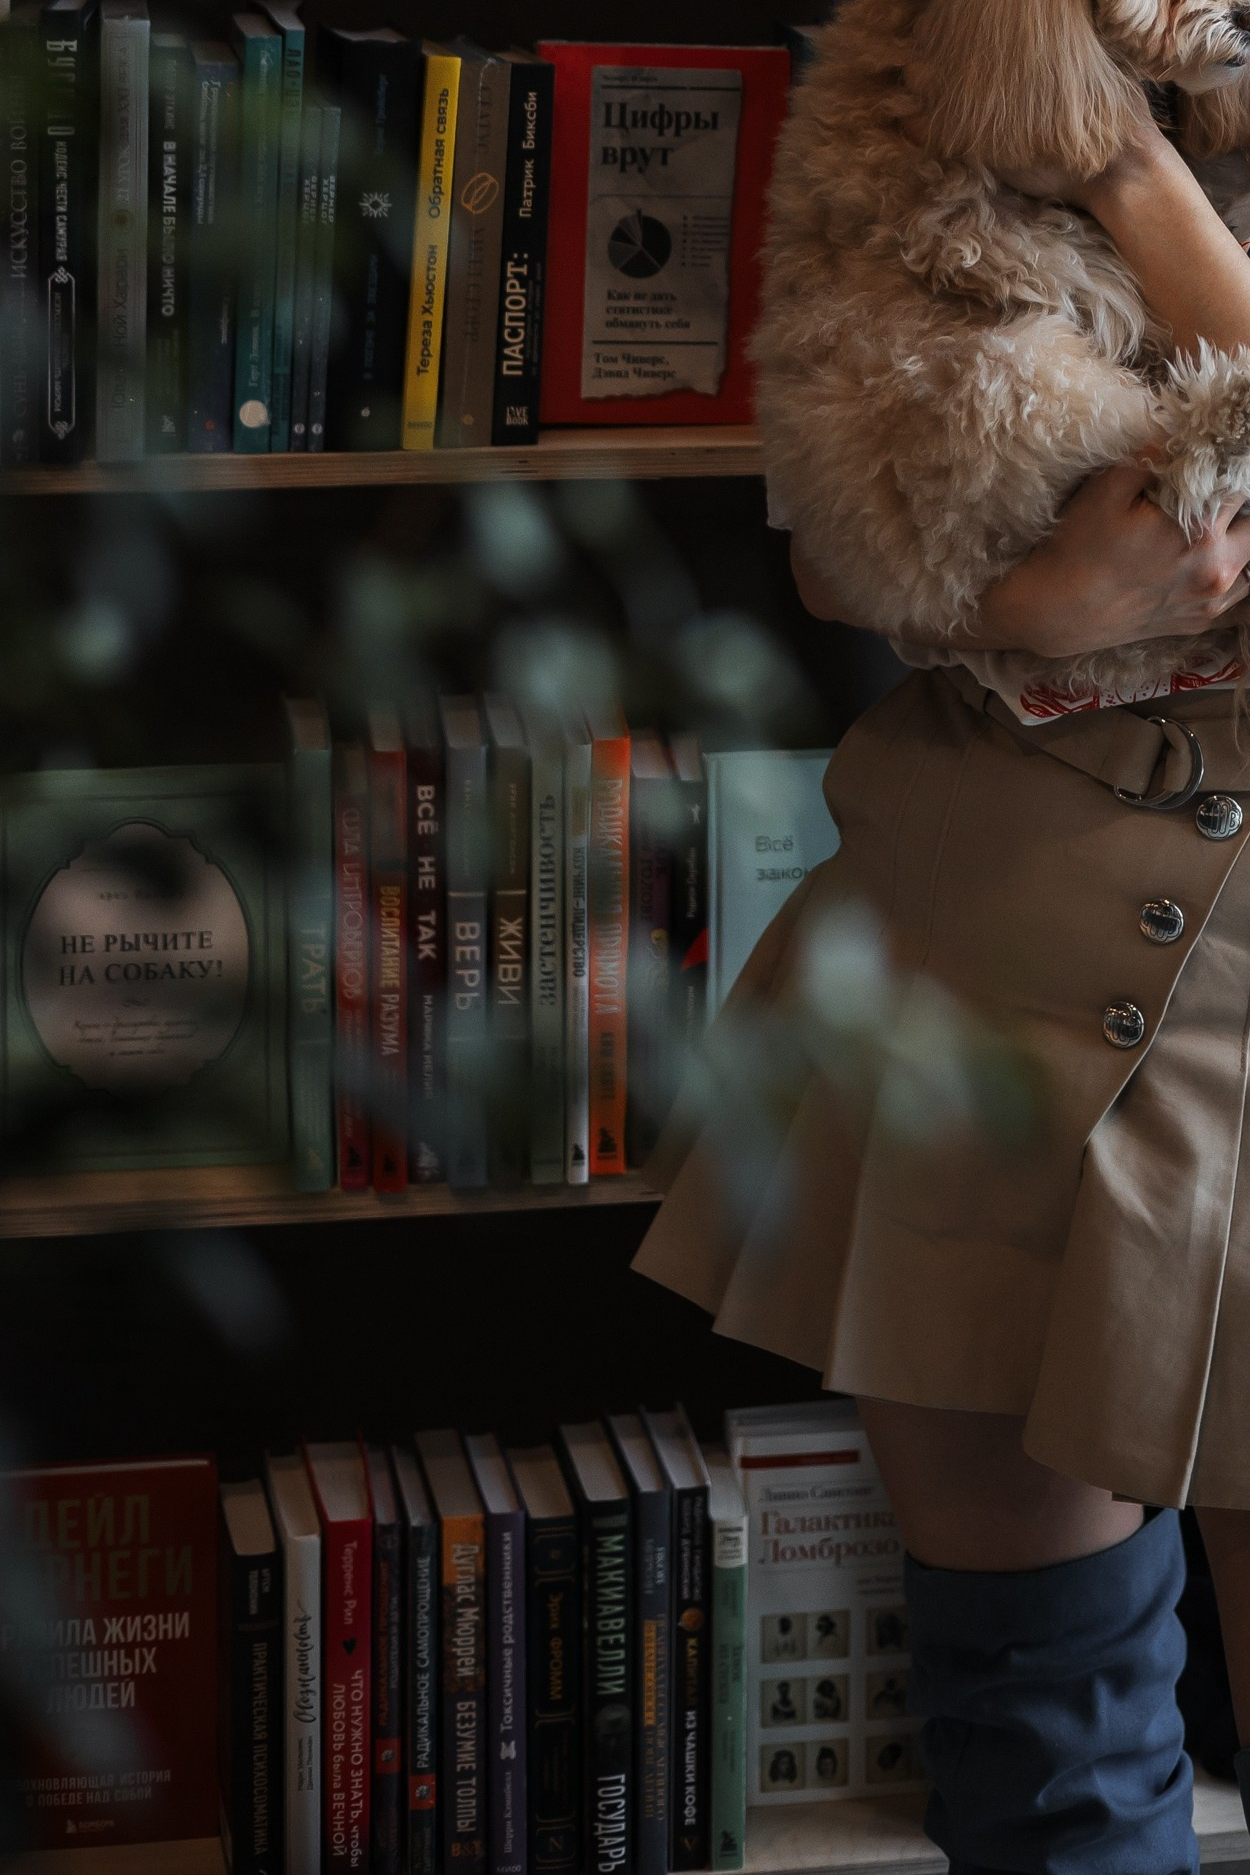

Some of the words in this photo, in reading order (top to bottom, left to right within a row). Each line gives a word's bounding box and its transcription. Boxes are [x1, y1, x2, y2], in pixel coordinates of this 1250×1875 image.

[434, 87, 451, 133] связь
[521, 90, 538, 149] Биксби
[602, 102, 719, 137] Цифры
[54, 141, 67, 180] КОДЕКС
[162, 141, 175, 151] В
[601, 142, 674, 173] врут
[55, 183, 67, 212] ЧЕСТИ
[161, 154, 175, 213] НАЧАЛЕ
[427, 138, 445, 218] Обратная
[519, 159, 536, 217] Патрик
[10, 158, 29, 278] ИСКУССТВО
[54, 215, 67, 262] САМУРАЯ
[160, 266, 174, 316] НИЧТО
[421, 244, 438, 315] Хьюстон
[502, 251, 528, 375] ПАСПОРТ:
[416, 319, 433, 374] Тереза
[593, 353, 619, 365] Том
[622, 354, 670, 366] Чиверс,
[633, 367, 677, 380] Чиверс
[416, 785, 439, 835] ВСЁ
[755, 835, 794, 852] Всё
[417, 856, 434, 890] НЕ
[537, 794, 556, 1006] Застенчивость
[339, 861, 362, 999] ИНТРОВЕРТОВ
[378, 885, 399, 988] ВОСПИТАНИЕ
[417, 910, 434, 960] ТАК
[571, 847, 584, 977] КОУЧИНГ-ЛИДЕРСТВО
[61, 935, 95, 955] НЕ
[104, 931, 213, 953] РЫЧИТЕ
[452, 921, 480, 1011] ВЕРЬ
[496, 917, 522, 1007] ЖИВИ
[593, 923, 621, 1015] ПРЯМОТА
[58, 966, 99, 986] НА
[104, 961, 223, 983] СОБАКУ!
[379, 993, 398, 1056] РАЗУМА
[23, 1494, 150, 1550] ДЕЙЛ
[340, 1542, 357, 1597] Терренс
[451, 1543, 481, 1604] Дуглас
[759, 1537, 900, 1566] Ломброзо
[342, 1600, 356, 1625] Рил
[415, 1555, 431, 1668] САМОПРОЩЕНИЕ
[500, 1531, 513, 1645] родственники
[594, 1534, 626, 1696] МАКИАВЕЛЛИ
[103, 1611, 190, 1645] ЖИЗНИ
[454, 1606, 482, 1681] Мюррей
[250, 1642, 267, 1740] ПРАКТИЧЕСКАЯ
[348, 1669, 362, 1703] ЧТО
[497, 1648, 514, 1734] Токсичные
[547, 1636, 561, 1701] ФРОММ
[331, 1684, 345, 1751] ЛЮБОВЬ
[348, 1706, 362, 1765] НУЖНО
[416, 1671, 431, 1768] РАДИКАЛЬНОЕ
[455, 1700, 479, 1772] БЕЗУМИЕ
[684, 1711, 695, 1728] ИЗ
[118, 1769, 171, 1784] ИСТОРИЯ
[331, 1754, 344, 1789] была
[684, 1731, 696, 1782] ЧАШКИ
[38, 1792, 83, 1806] ПОБЕДЕ
[87, 1791, 111, 1804] НАД
[114, 1786, 152, 1802] СОБОЙ
[252, 1744, 269, 1855] ПСИХОСОМАТИКА
[331, 1792, 347, 1856] ВЕЧНОЙ
[347, 1768, 362, 1823] ЗНАТЬ,
[455, 1775, 478, 1833] ТОЛПЫ
[592, 1774, 626, 1872] ГОСУДАРЬ
[683, 1785, 696, 1825] КОФЕ
[348, 1825, 361, 1868] чтобы
